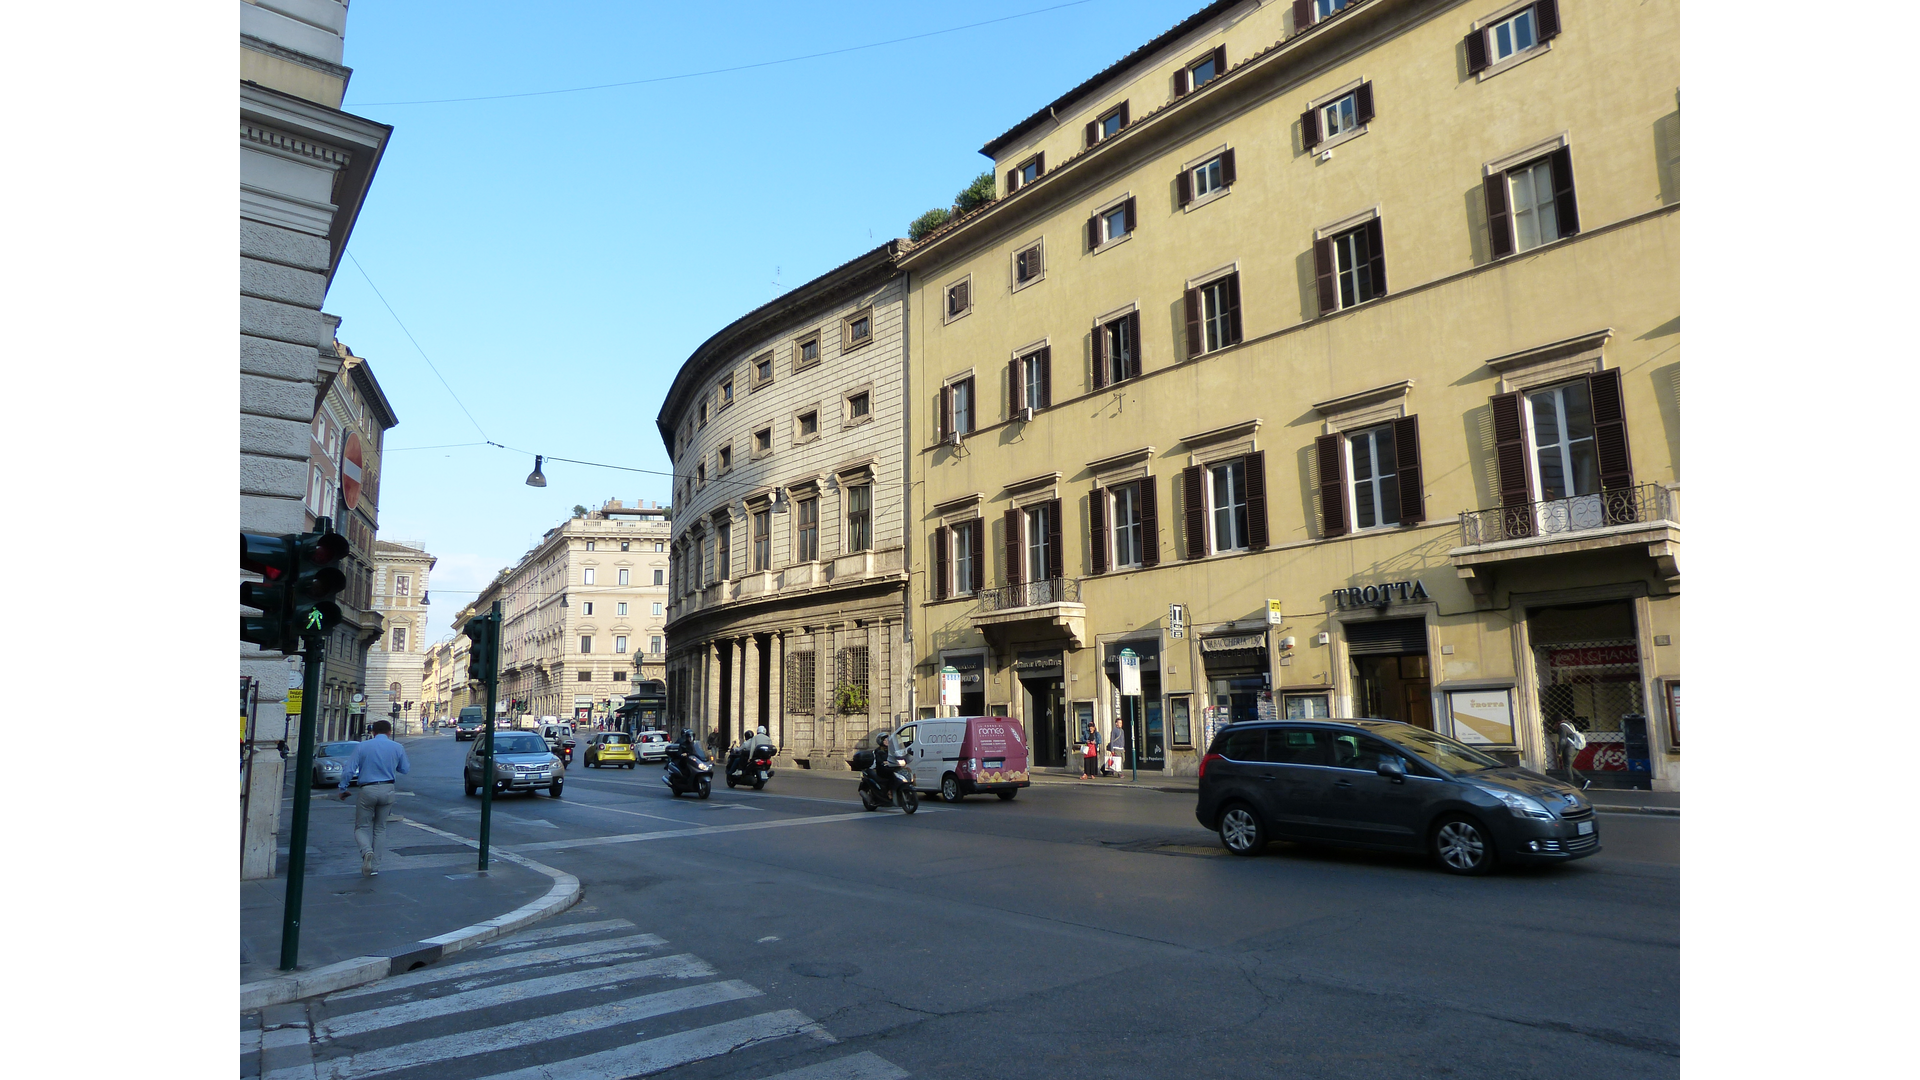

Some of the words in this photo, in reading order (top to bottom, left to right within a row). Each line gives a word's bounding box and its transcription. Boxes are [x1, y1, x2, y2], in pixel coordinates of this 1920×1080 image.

[1332, 579, 1430, 607] TROTTA
[1205, 636, 1247, 649] TABACCHERIA
[927, 733, 958, 743] romeo
